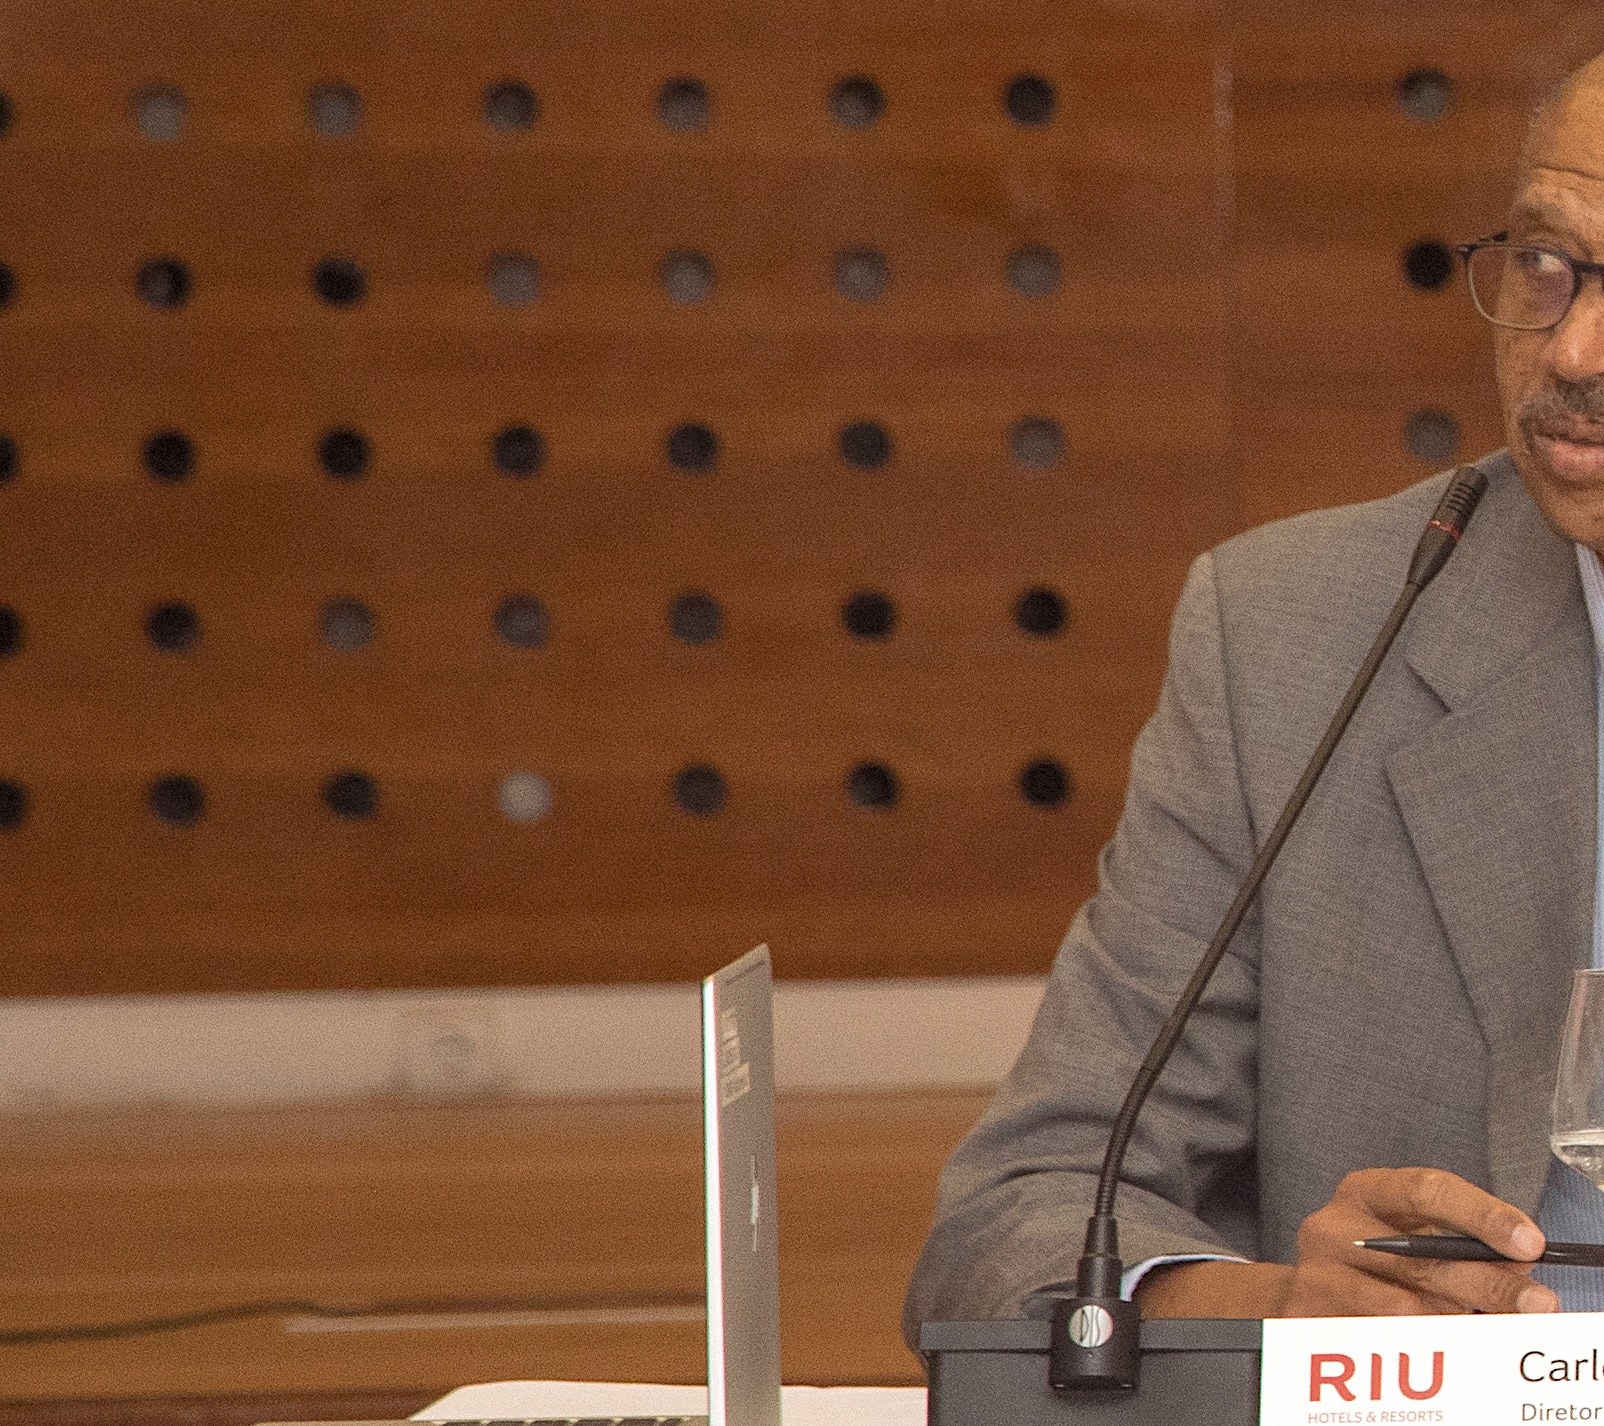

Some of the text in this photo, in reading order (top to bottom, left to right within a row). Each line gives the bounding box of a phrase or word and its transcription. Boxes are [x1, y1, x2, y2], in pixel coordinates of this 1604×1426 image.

[1308, 1350, 1446, 1403] RIU
[1308, 1410, 1443, 1424] HOTELS & RESORTS
[1521, 1402, 1604, 1422] Diretor
